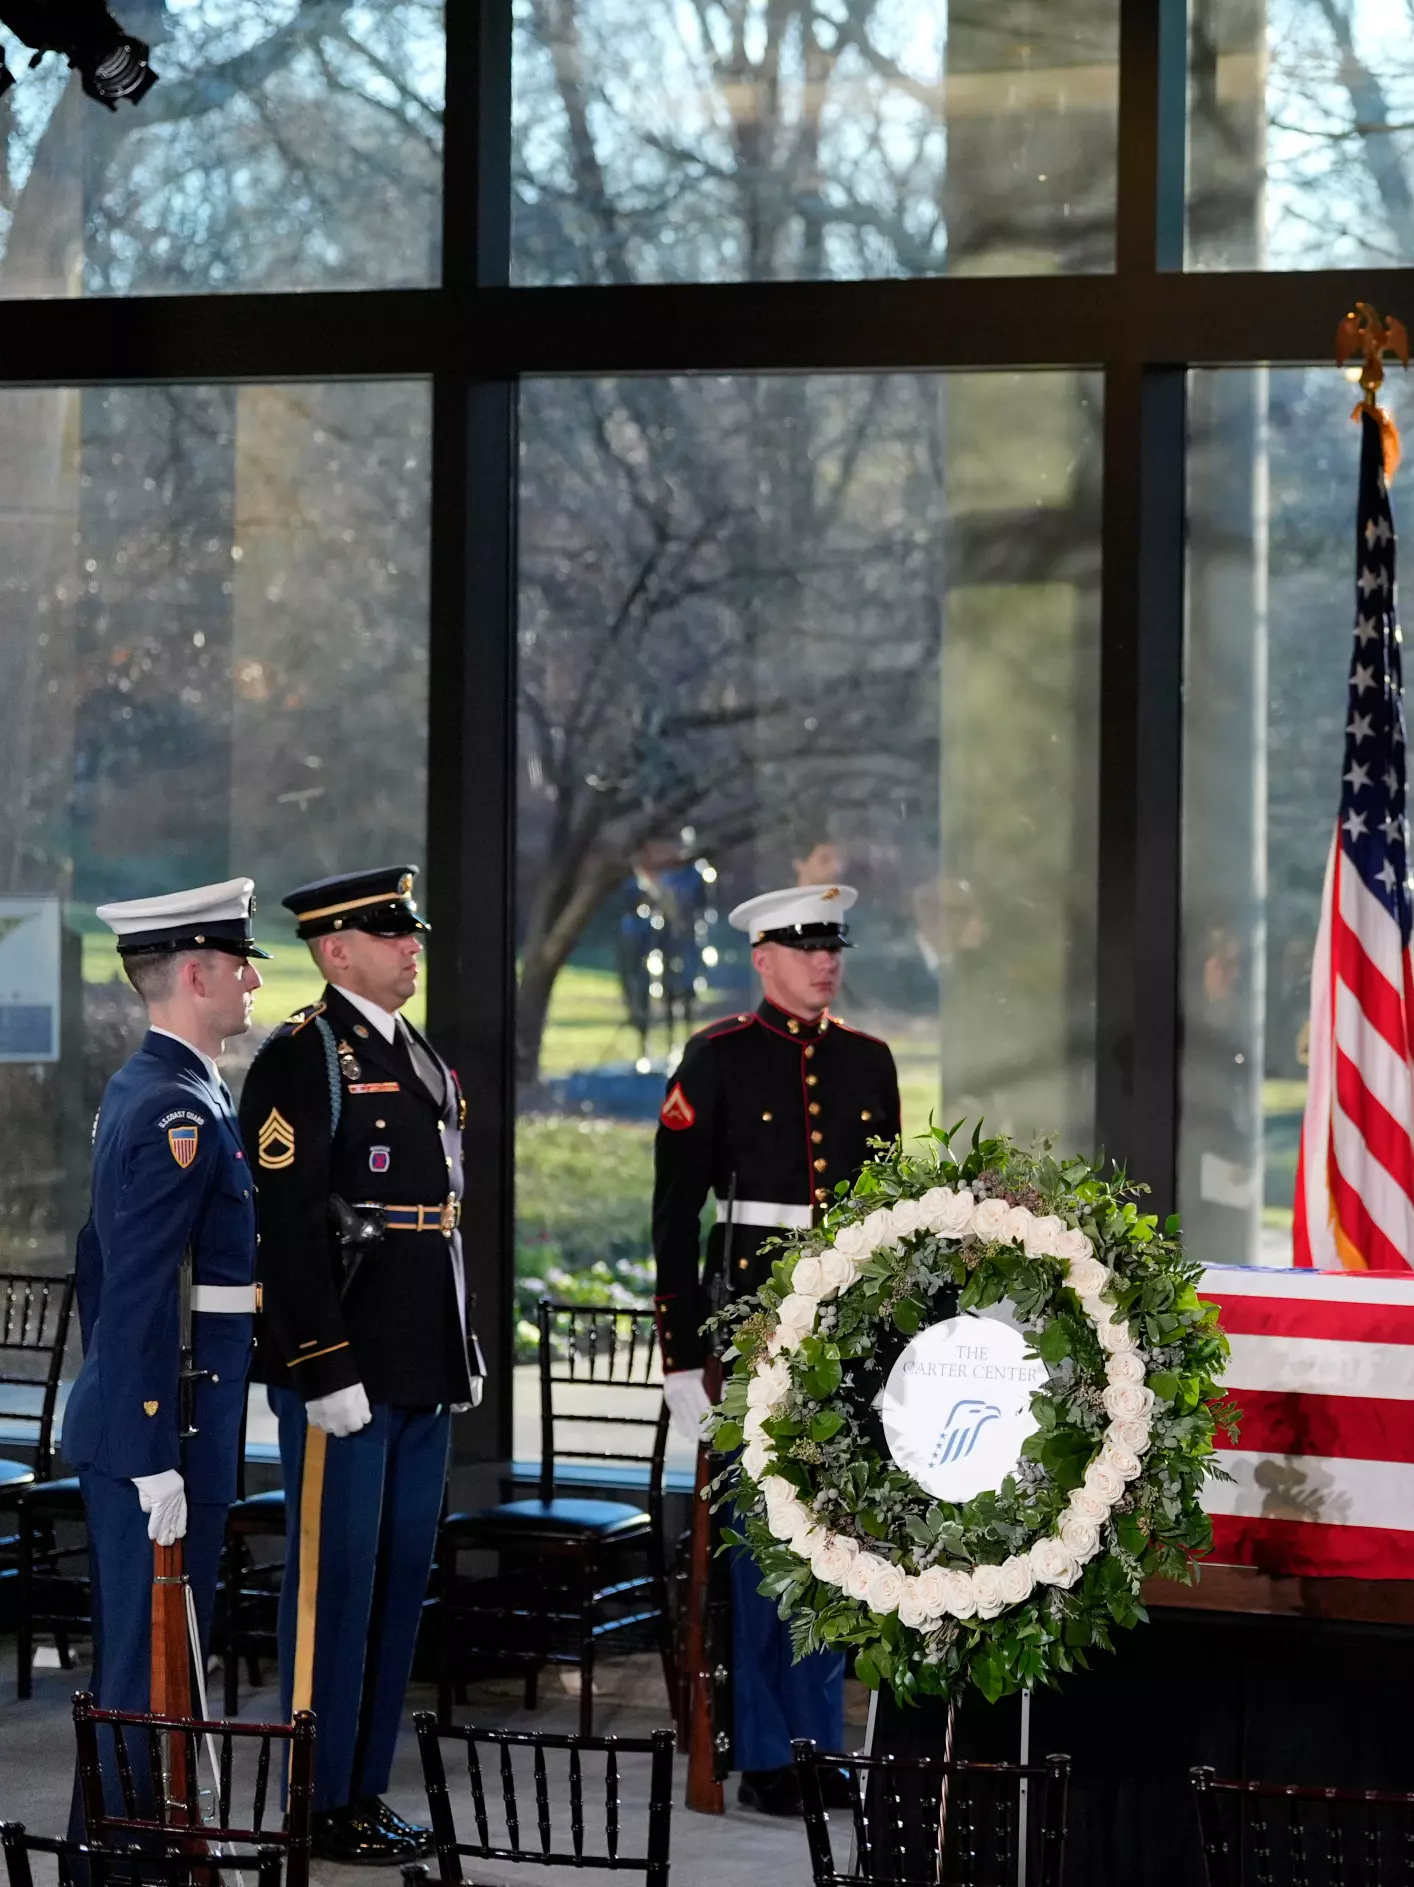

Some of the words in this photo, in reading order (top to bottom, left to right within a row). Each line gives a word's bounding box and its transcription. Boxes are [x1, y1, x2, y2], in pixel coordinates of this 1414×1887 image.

[186, 1111, 205, 1126] GUARD
[955, 1345, 989, 1361] THE
[903, 1361, 968, 1378] CARTER
[972, 1365, 1037, 1382] CENTER
